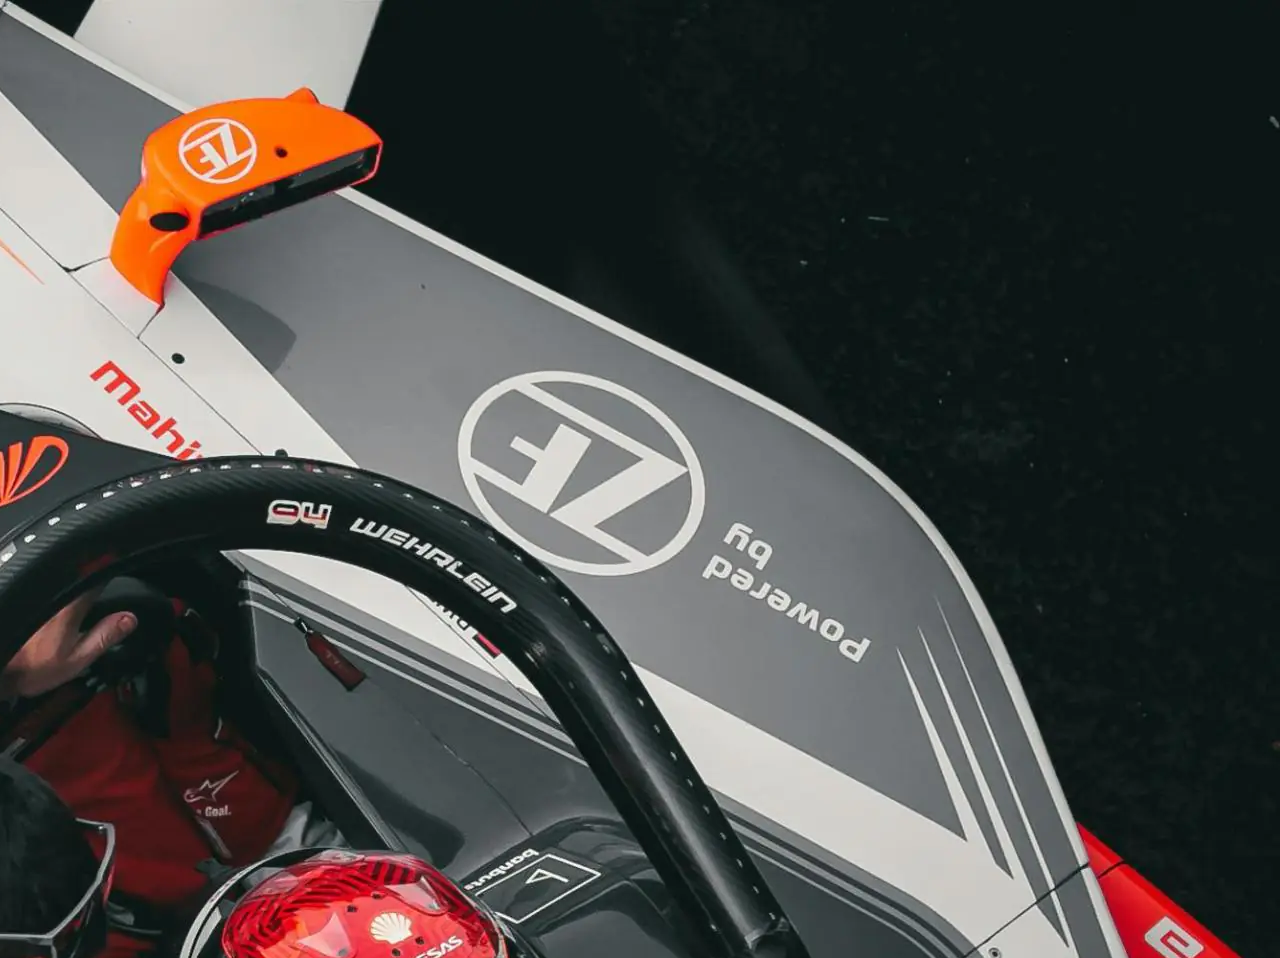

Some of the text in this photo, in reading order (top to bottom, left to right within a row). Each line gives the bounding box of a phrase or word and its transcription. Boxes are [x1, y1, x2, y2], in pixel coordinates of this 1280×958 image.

[178, 118, 257, 184] ZF
[465, 374, 700, 572] ZF
[267, 500, 517, 613] 94 WEHRLEIN
[723, 522, 773, 570] by
[703, 555, 871, 662] Powered
